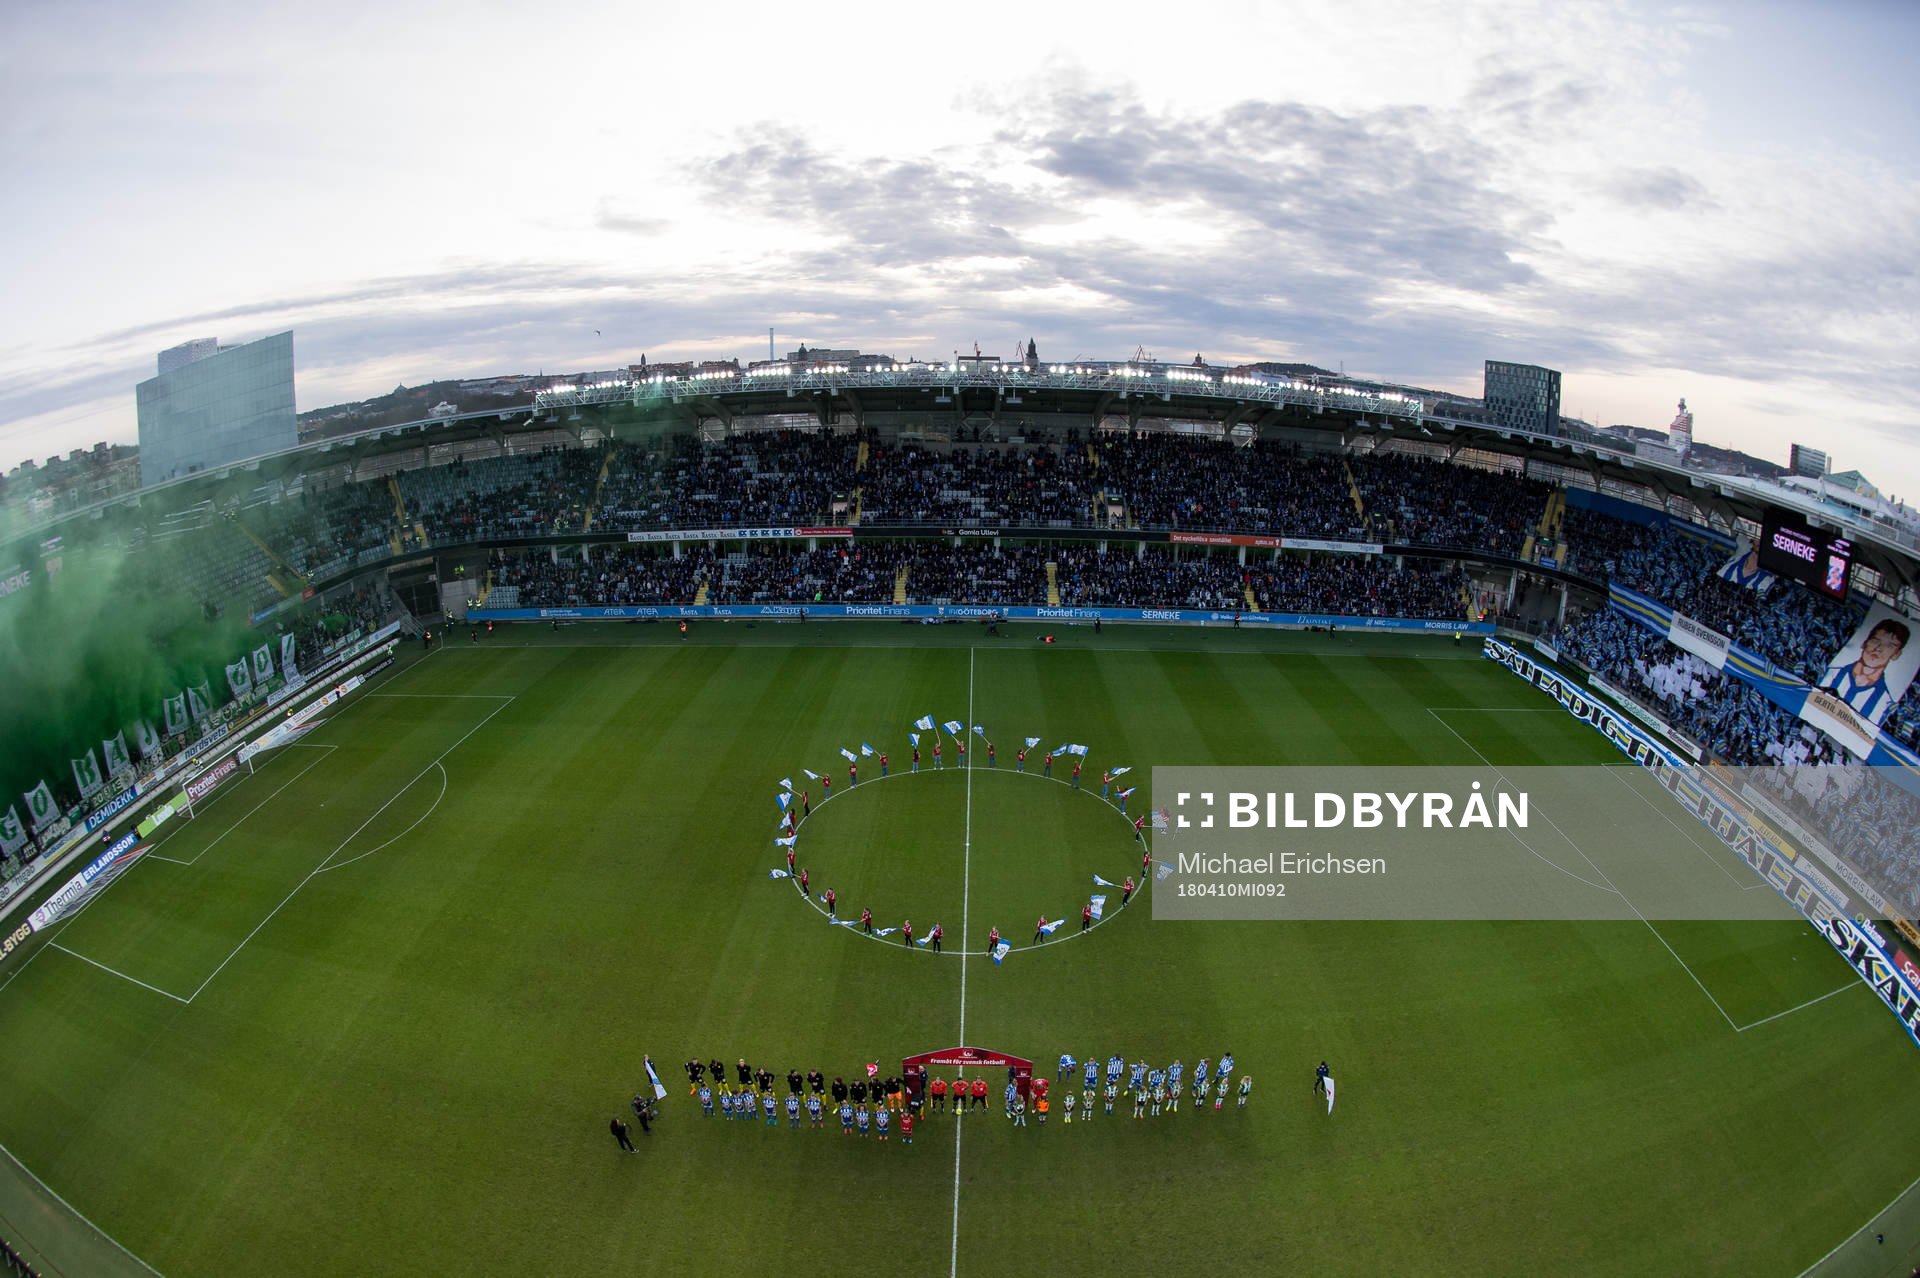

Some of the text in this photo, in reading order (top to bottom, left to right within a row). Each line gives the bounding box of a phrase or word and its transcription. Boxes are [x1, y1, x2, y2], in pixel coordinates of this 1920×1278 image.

[1773, 533, 1817, 562] SERNEKE
[0, 570, 31, 597] NEKE
[846, 606, 882, 615] Prioritet
[1037, 608, 1100, 618] Prioritet Finans
[1142, 610, 1181, 620] SERNEKE
[1425, 622, 1452, 630] MORRIS
[1678, 618, 1726, 648] RUBEN SVENSSON
[1489, 642, 1564, 702] SÄLLA
[1568, 692, 1618, 741] DIG
[1814, 696, 1873, 740] BERTIL JOHANS
[184, 725, 227, 760] nordsvets
[188, 760, 236, 798] Prioritet Finans
[88, 789, 134, 828] DEMIDEKK
[83, 836, 134, 880] ERLANDSSON
[44, 880, 83, 916] Thermia
[1835, 862, 1884, 910] MORRIS LAW
